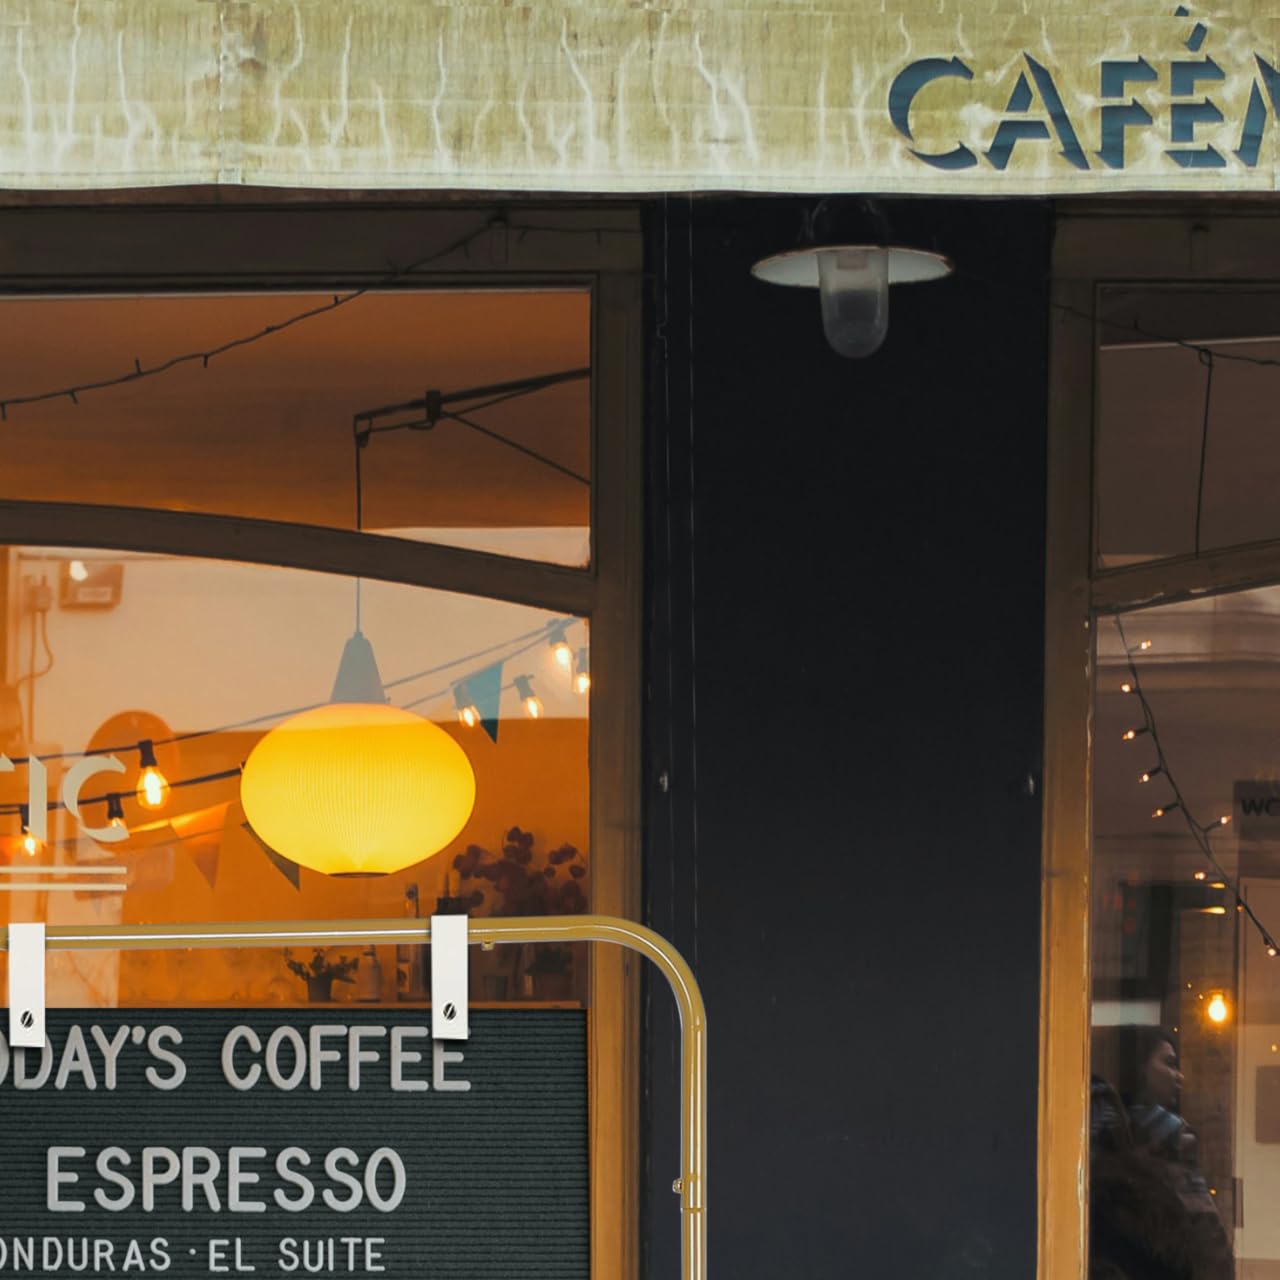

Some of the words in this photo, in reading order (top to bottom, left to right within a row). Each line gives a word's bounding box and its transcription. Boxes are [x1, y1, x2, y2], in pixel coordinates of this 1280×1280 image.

[221, 1024, 472, 1092] COFFEE
[46, 1146, 407, 1213] ESPRESSO
[208, 1237, 256, 1273] EL
[278, 1236, 387, 1273] SUITE
